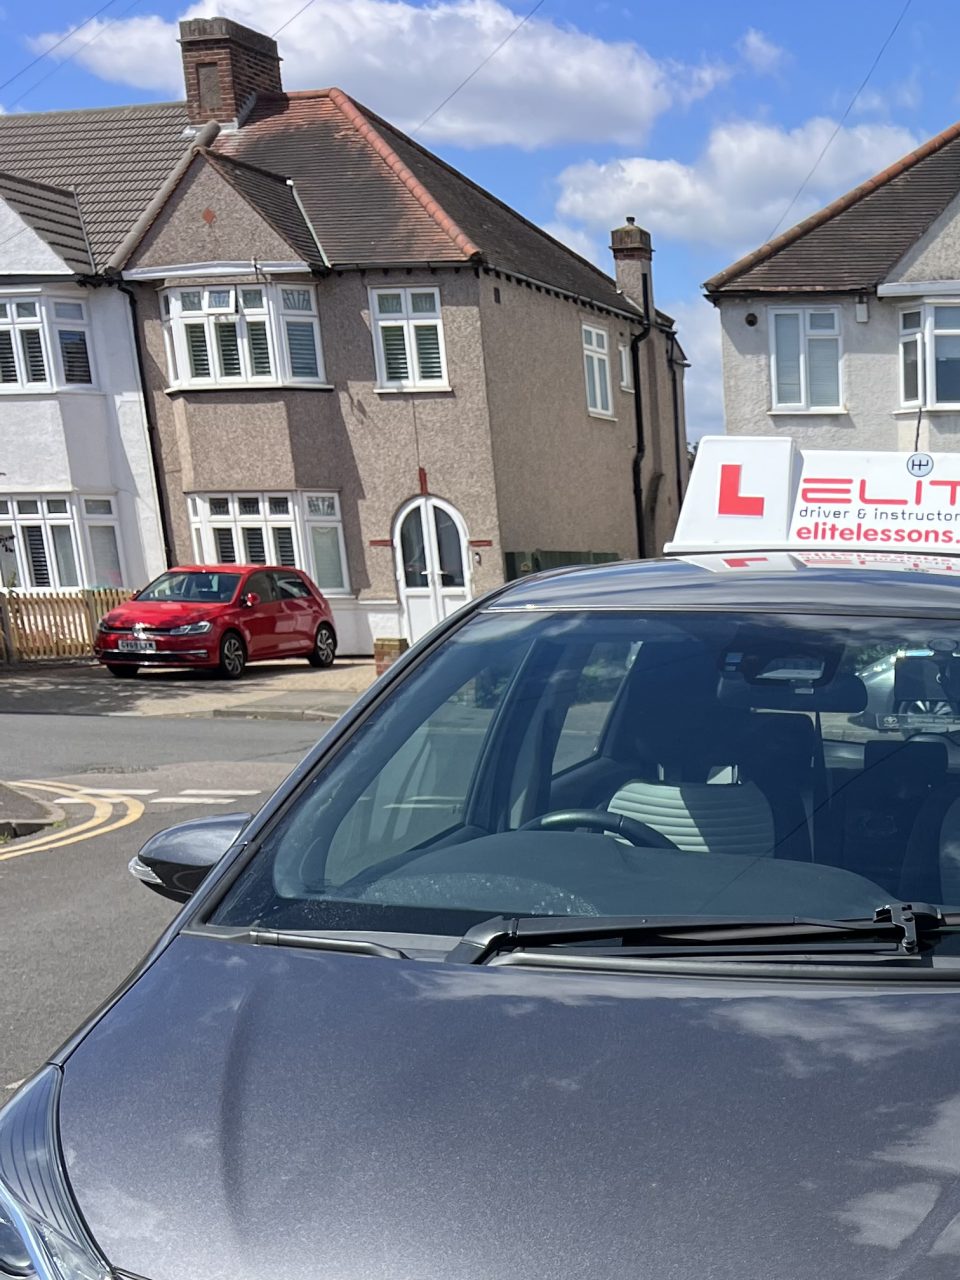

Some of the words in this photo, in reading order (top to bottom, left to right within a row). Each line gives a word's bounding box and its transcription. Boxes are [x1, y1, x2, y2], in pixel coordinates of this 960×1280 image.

[717, 464, 765, 517] L
[799, 506, 849, 519] driver
[857, 508, 867, 519] &
[874, 508, 960, 522] instructor
